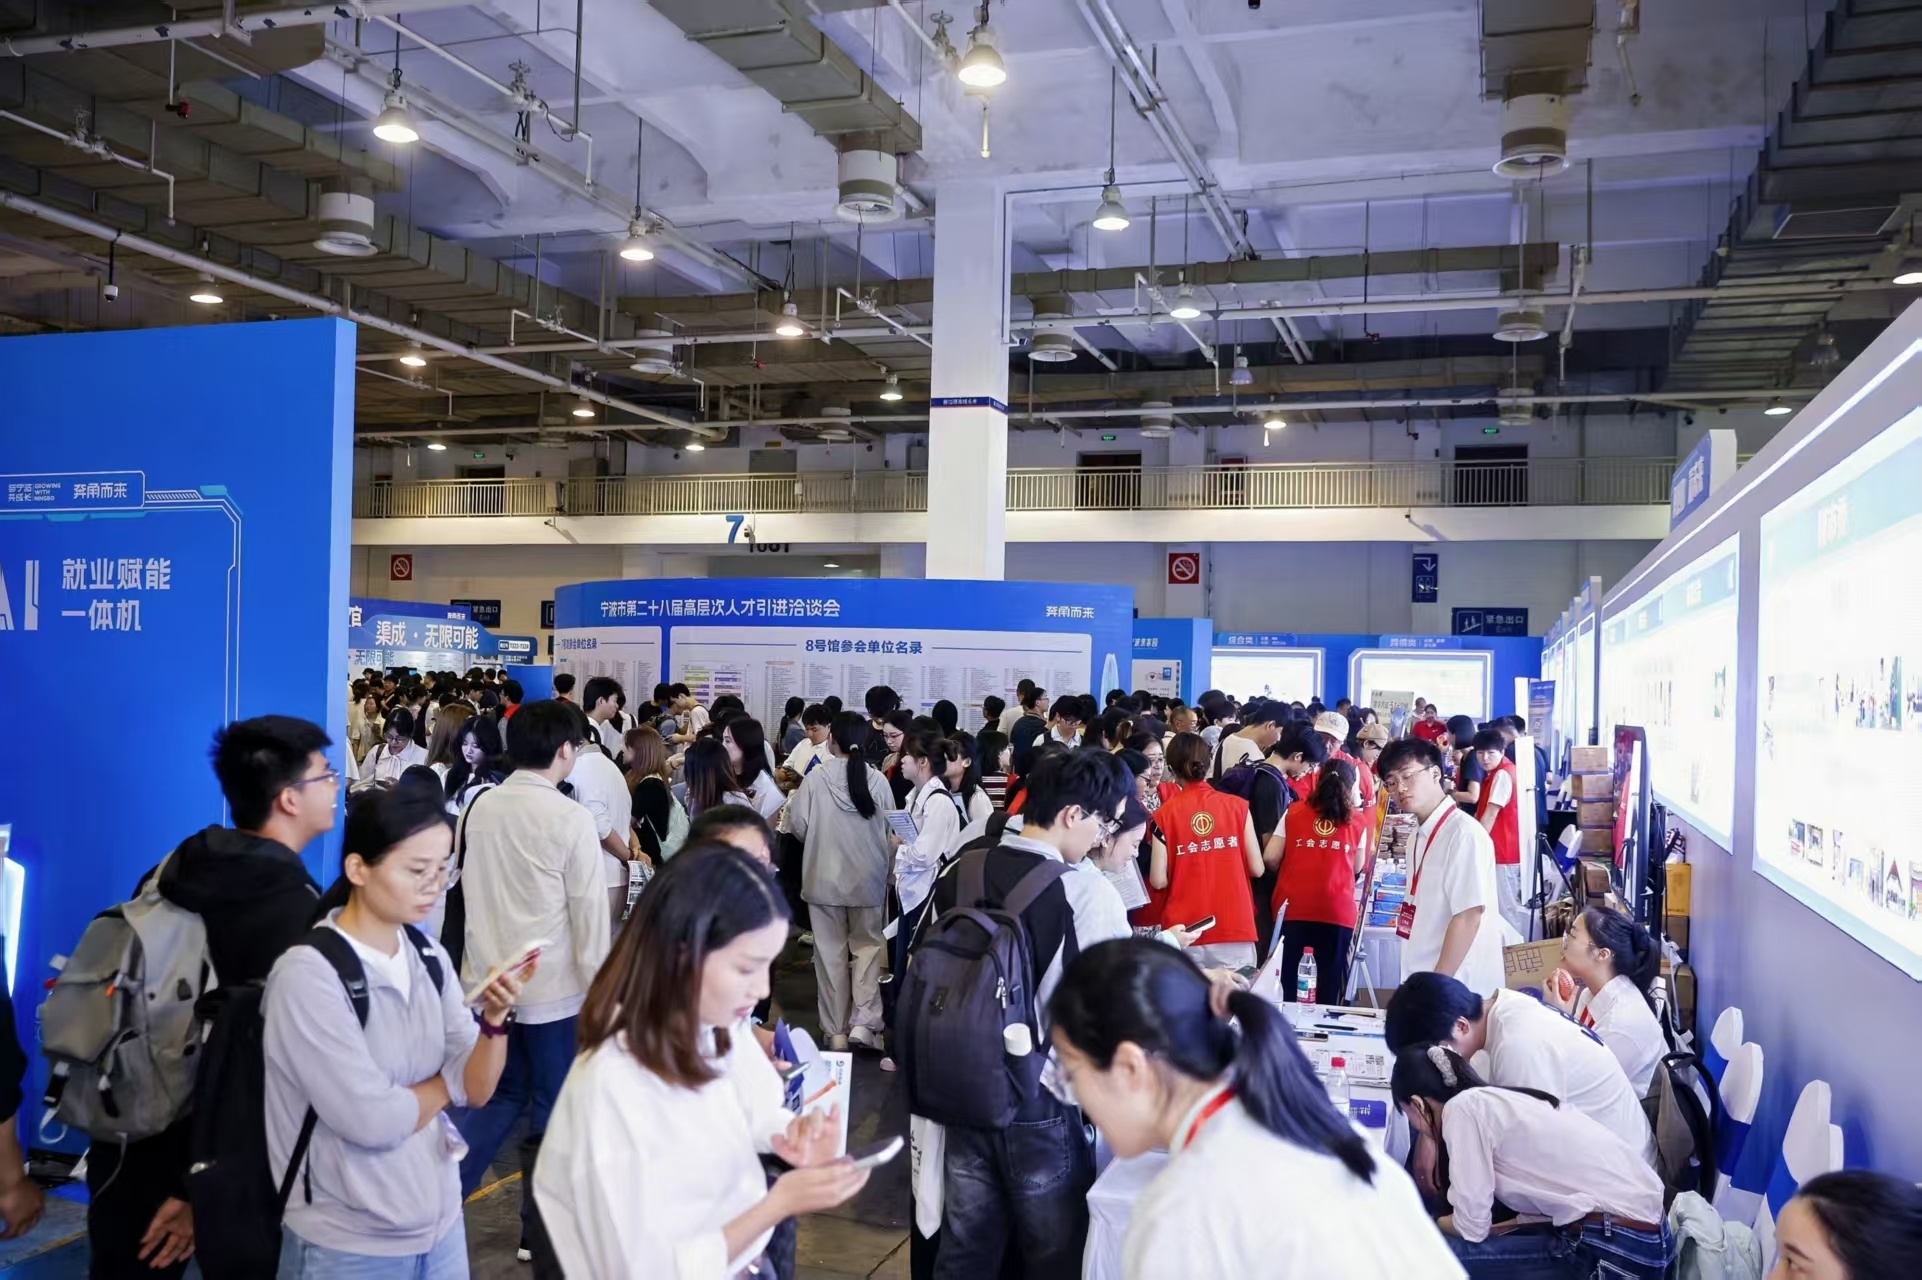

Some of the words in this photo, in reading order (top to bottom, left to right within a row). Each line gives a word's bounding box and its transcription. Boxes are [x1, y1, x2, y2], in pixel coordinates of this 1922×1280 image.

[73, 482, 127, 499] 奔甬而来
[726, 515, 744, 544] 7
[62, 558, 170, 590] 就业赋能
[61, 599, 141, 631] 一体机
[600, 598, 841, 618] 宁波市第二十八届高层次人才引进洽谈会
[1045, 605, 1094, 619] 奔甬而来
[805, 639, 923, 655] 8号馆参会单位名录
[1176, 835, 1238, 856] 工会志愿者
